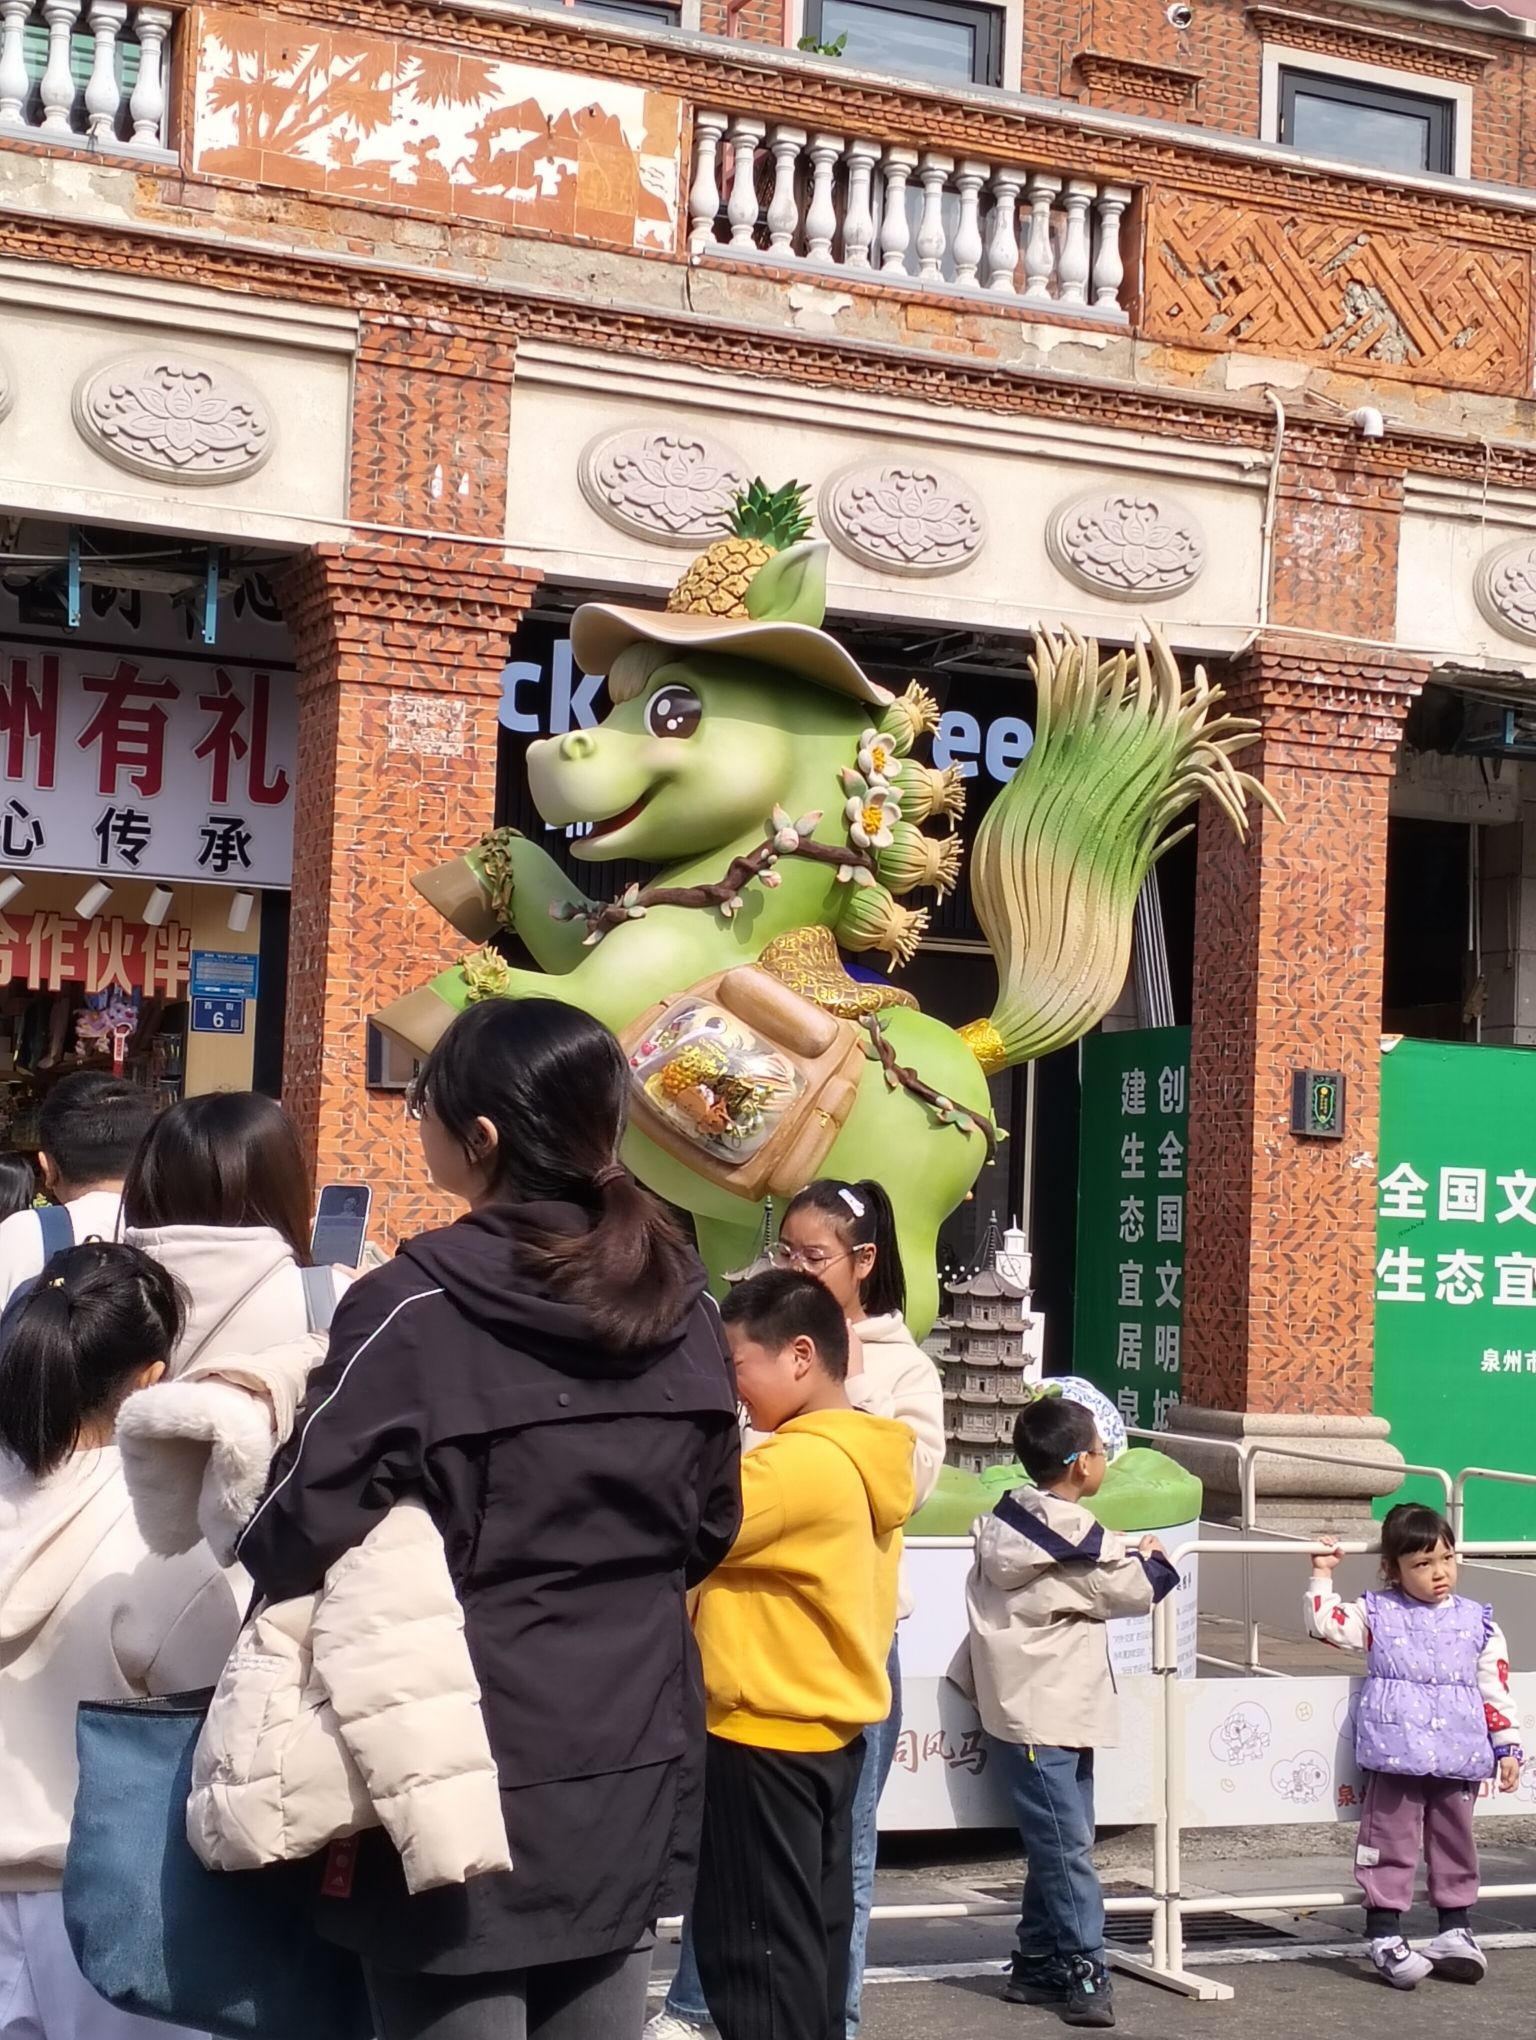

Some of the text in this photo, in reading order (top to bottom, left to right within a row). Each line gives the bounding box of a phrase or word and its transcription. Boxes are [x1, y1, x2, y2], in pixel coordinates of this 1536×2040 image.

[0, 654, 290, 806] 州有礼
[0, 797, 253, 873] 心传承
[213, 1011, 224, 1028] 6
[1378, 1162, 1536, 1225] 全国文
[1376, 1246, 1536, 1307] 生态宜
